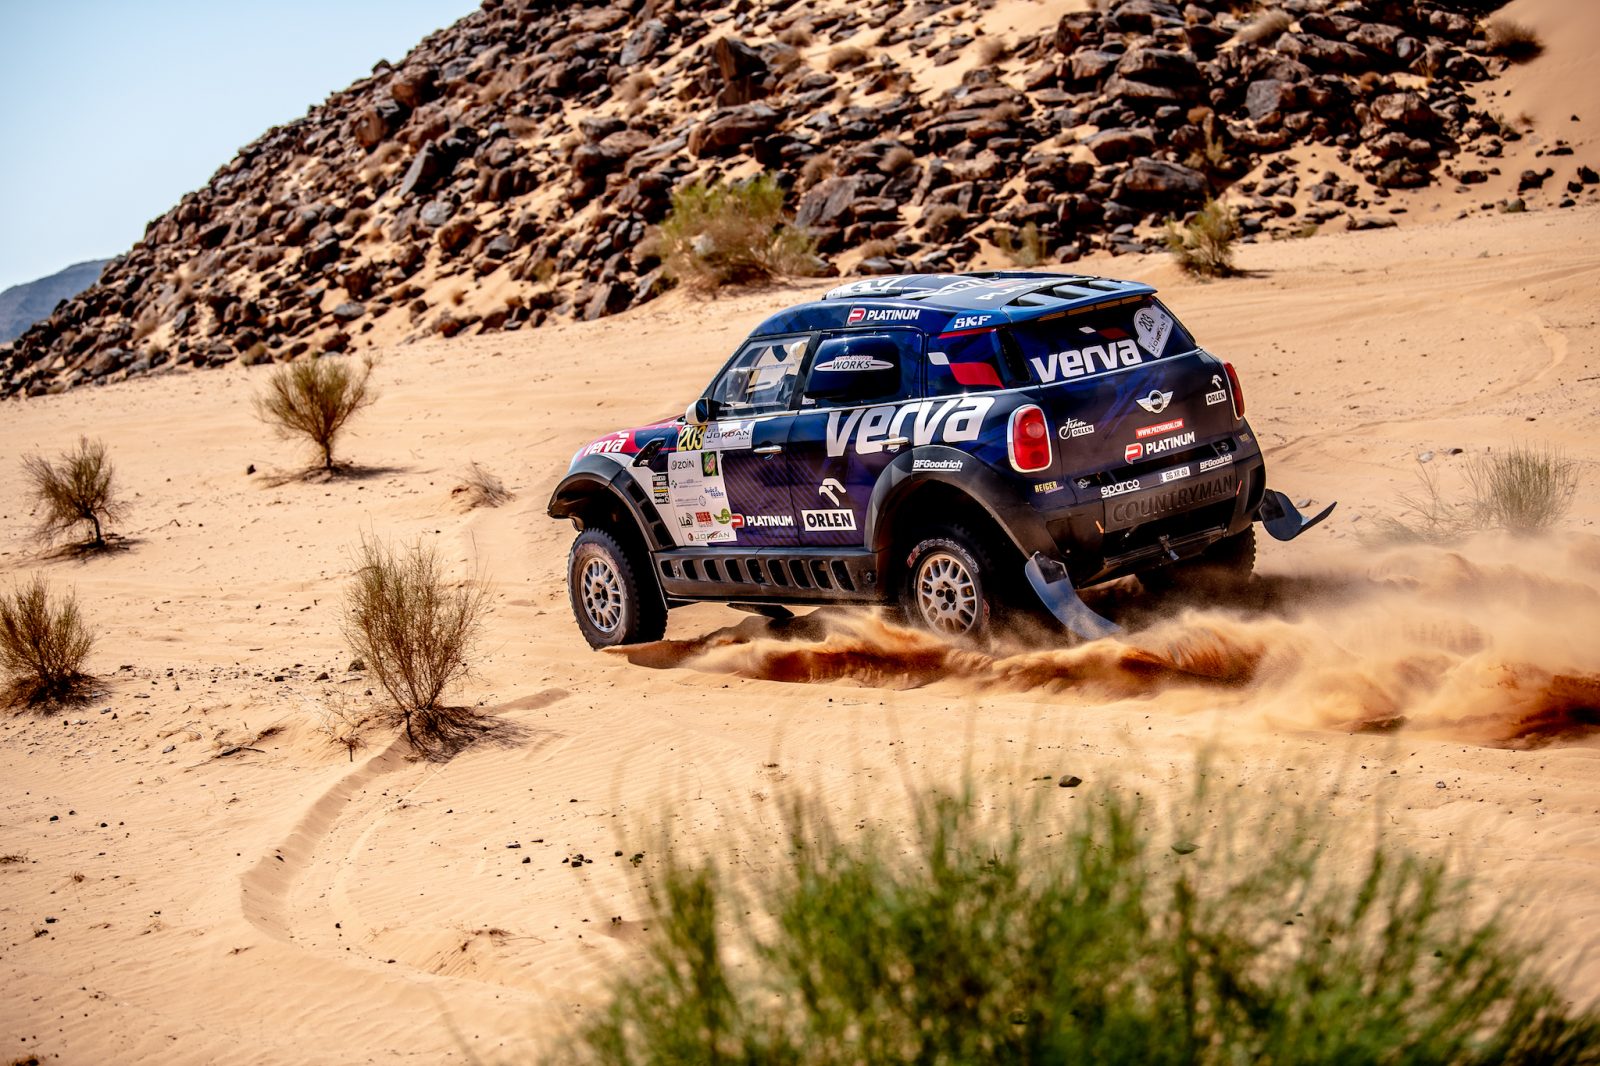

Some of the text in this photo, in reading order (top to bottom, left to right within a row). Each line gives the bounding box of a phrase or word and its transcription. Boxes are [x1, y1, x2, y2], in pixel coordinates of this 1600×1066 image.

[866, 309, 921, 321] PLATINUM
[953, 315, 992, 329] SKF
[832, 360, 872, 370] WORKS
[1030, 338, 1143, 384] verva
[1207, 390, 1226, 404] ORLEN
[706, 429, 751, 439] JORDAN
[826, 396, 996, 458] verva
[1073, 425, 1093, 436] ORLEN
[678, 424, 708, 451] 203
[1146, 431, 1196, 455] PLATINUM
[583, 438, 628, 457] verva
[913, 459, 963, 470] BFGoodrich
[1200, 453, 1233, 470] BFGoodrich
[1101, 479, 1140, 497] sparco
[1113, 475, 1233, 523] COUNTRYMAN
[746, 515, 794, 527] PLATINUM
[806, 512, 853, 528] ORLEN
